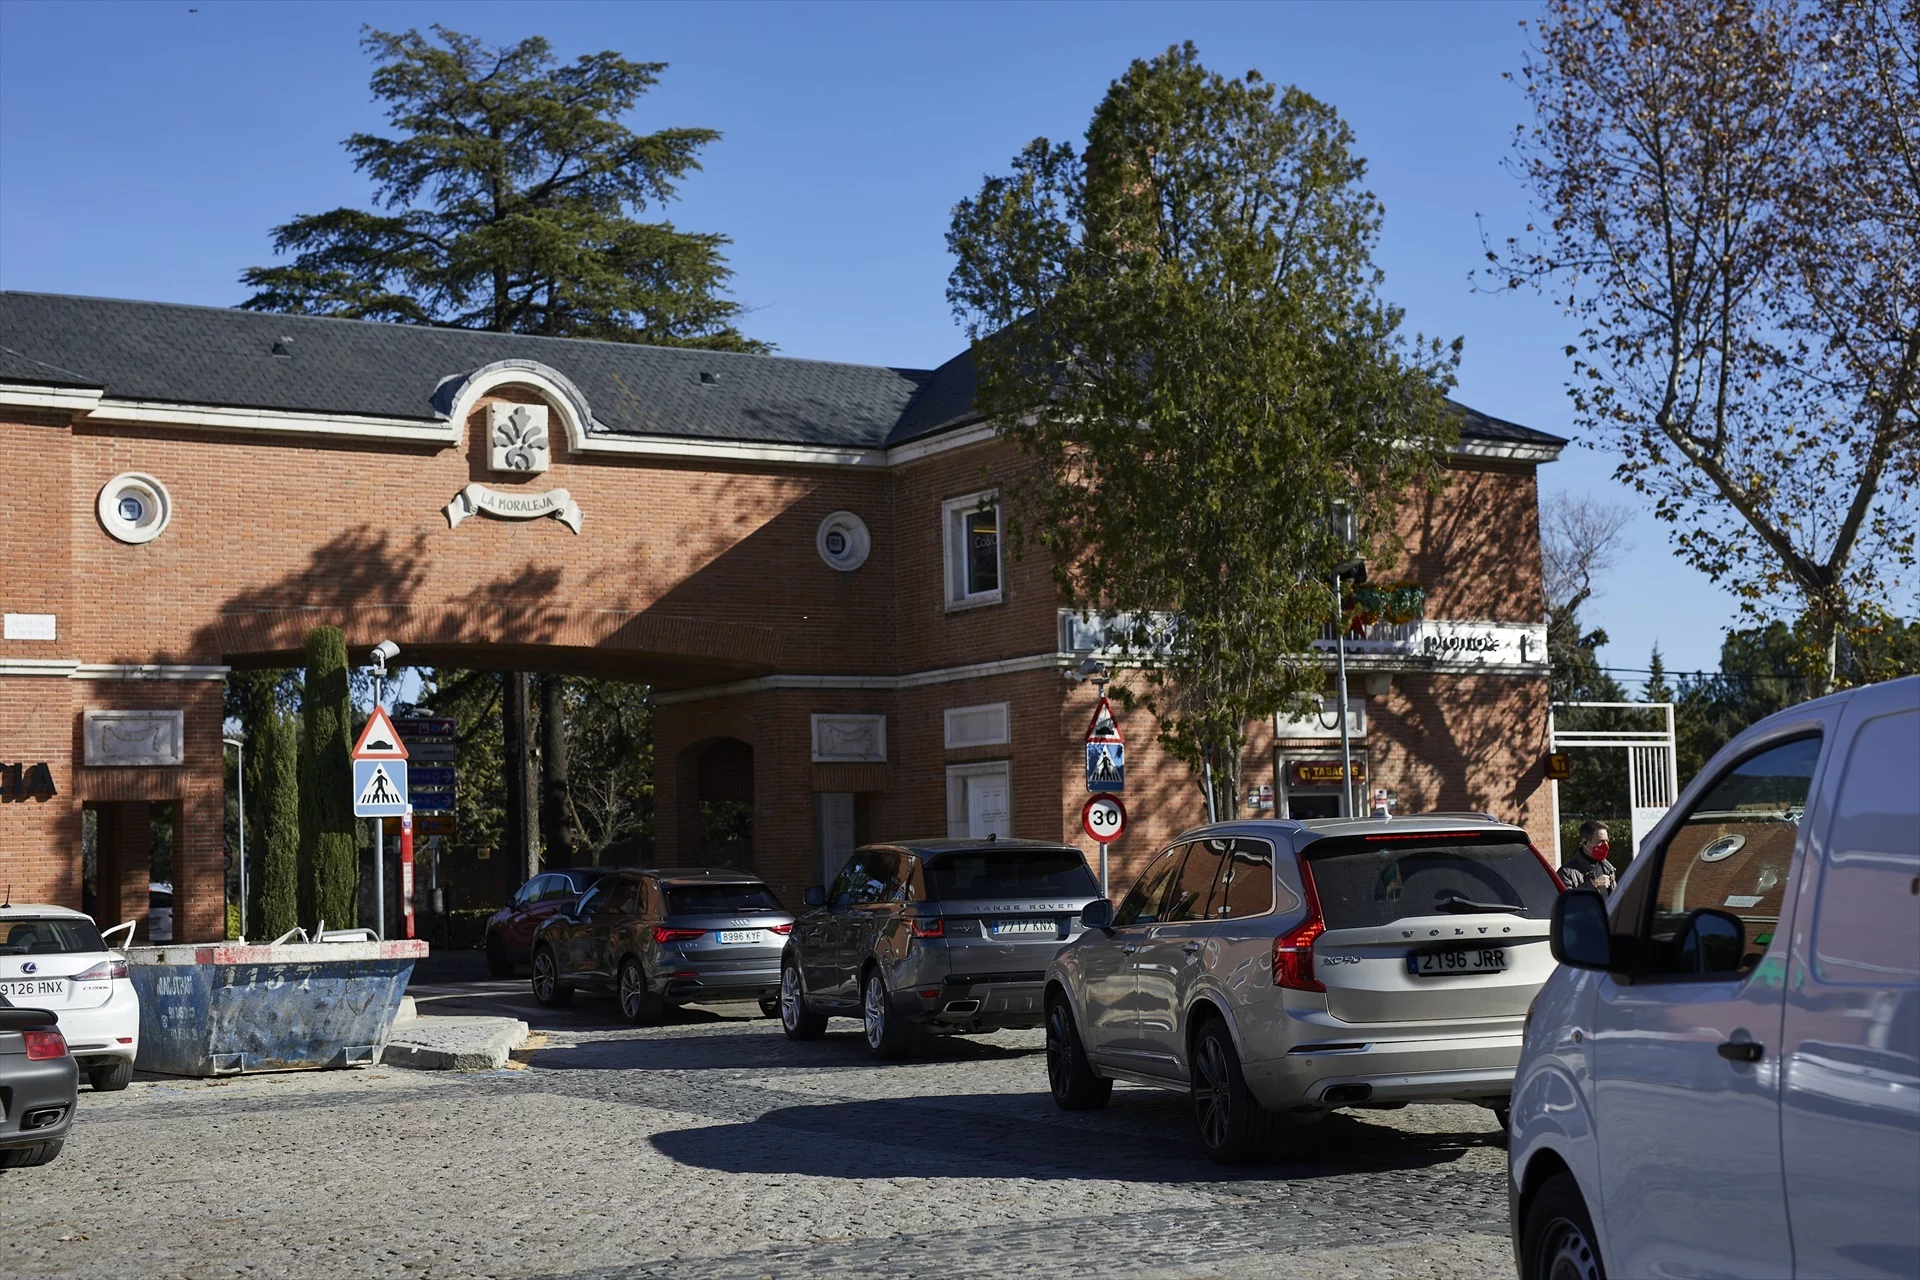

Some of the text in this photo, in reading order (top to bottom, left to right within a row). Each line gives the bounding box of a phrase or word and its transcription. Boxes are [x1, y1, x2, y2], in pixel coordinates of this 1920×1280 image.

[480, 492, 554, 512] LA MORALEJA
[1313, 766, 1359, 776] TABACS
[1092, 809, 1118, 826] 30
[973, 904, 1021, 912] RANGE
[1001, 919, 1054, 933] 7717 KNX
[1401, 926, 1512, 939] VOLVO
[722, 931, 761, 941] 8996 KYF
[1322, 955, 1363, 968] XC90
[1423, 949, 1506, 970] 2196 JRR
[0, 981, 63, 996] 9126 HNX
